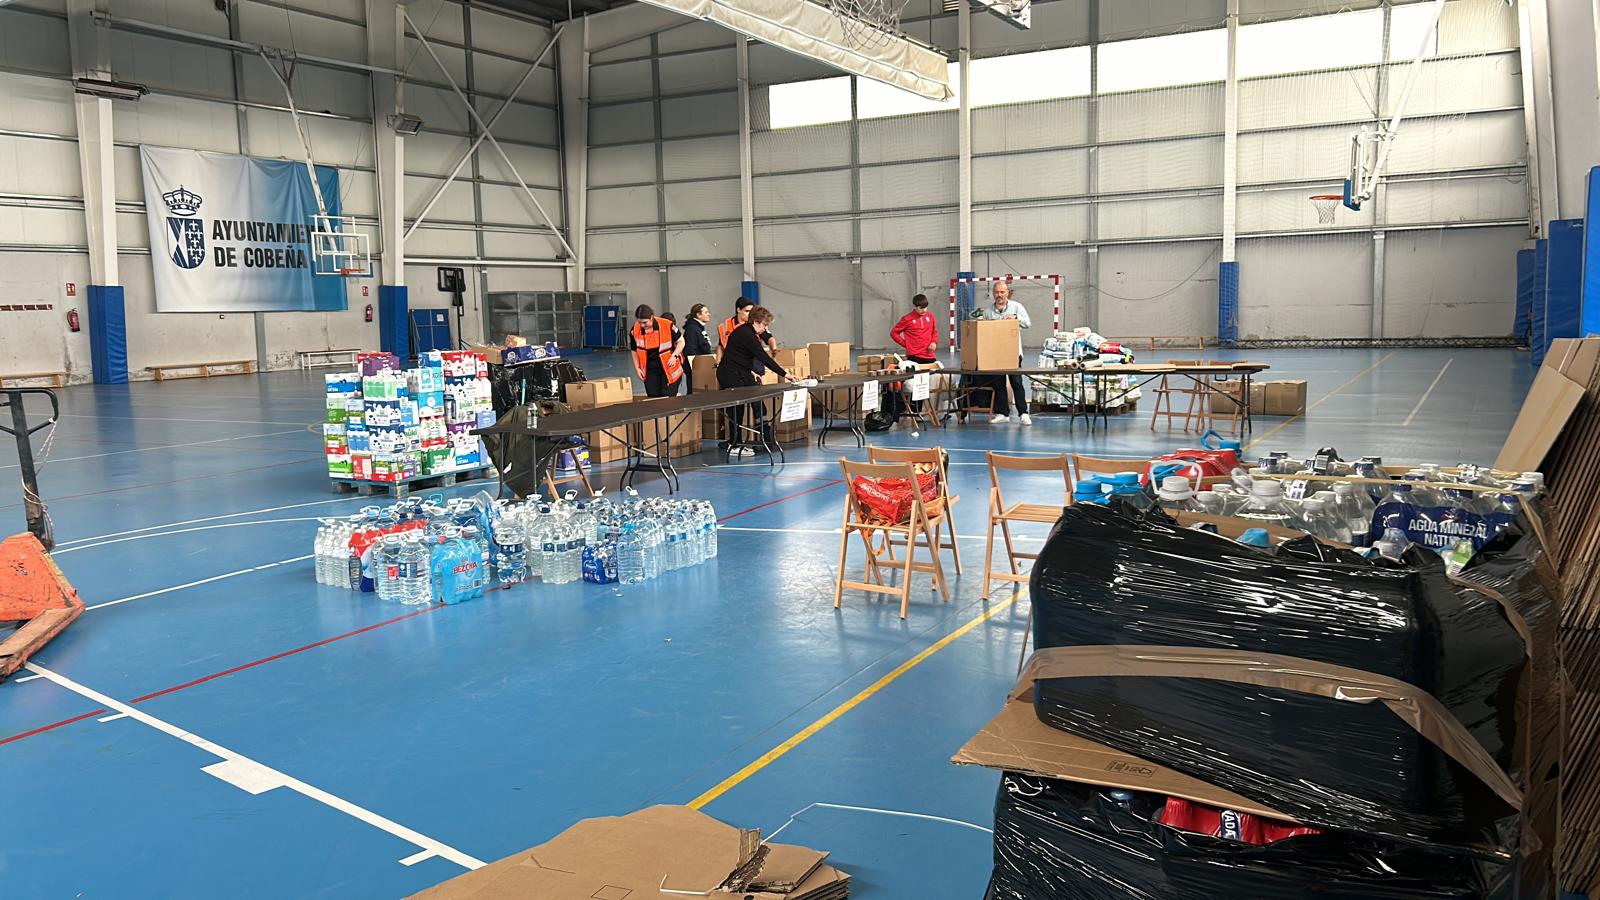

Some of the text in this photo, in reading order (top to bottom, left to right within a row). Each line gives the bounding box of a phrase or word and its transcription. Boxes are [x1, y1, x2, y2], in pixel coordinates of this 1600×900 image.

[213, 245, 309, 269] DE COBEÑA
[1408, 518, 1489, 540] AGUA MINERAL
